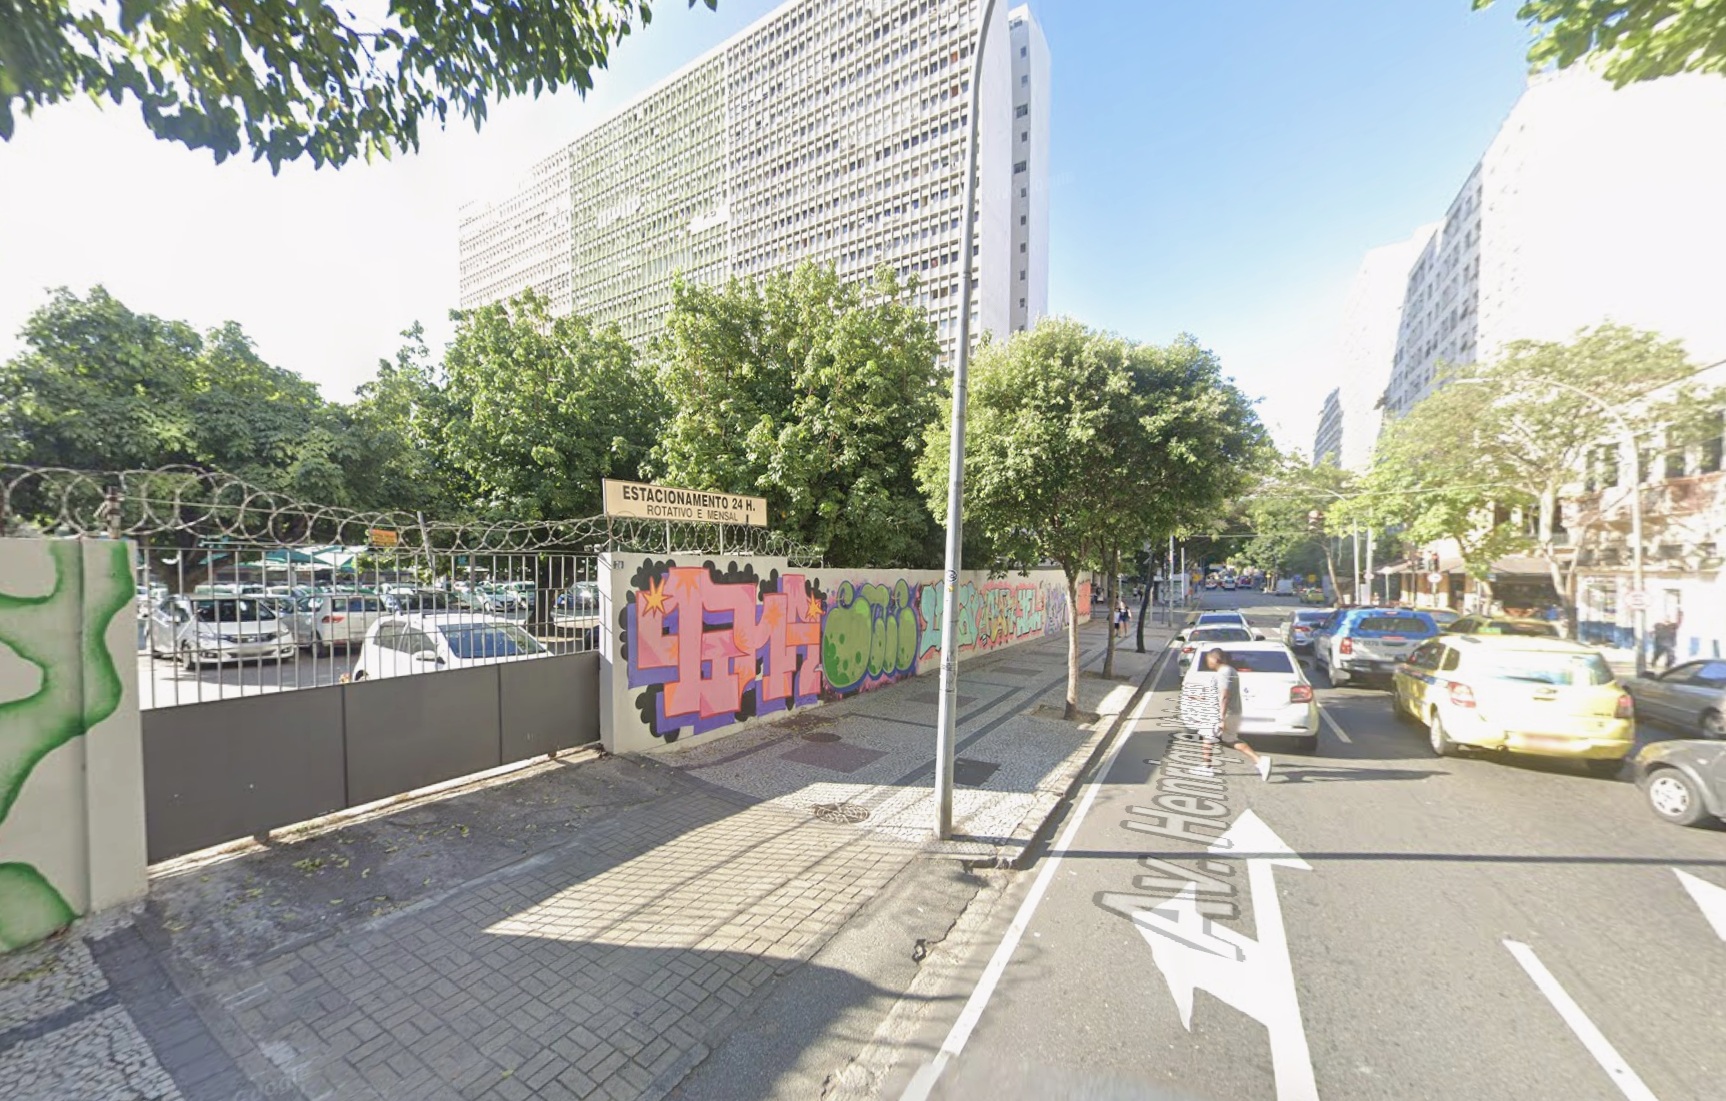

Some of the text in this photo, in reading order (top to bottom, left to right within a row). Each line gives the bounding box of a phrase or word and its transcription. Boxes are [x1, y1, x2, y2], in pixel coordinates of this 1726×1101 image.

[622, 485, 756, 512] ESTACIONAMENTO 24 H.
[647, 504, 738, 522] ROTATIVO E MENSAL
